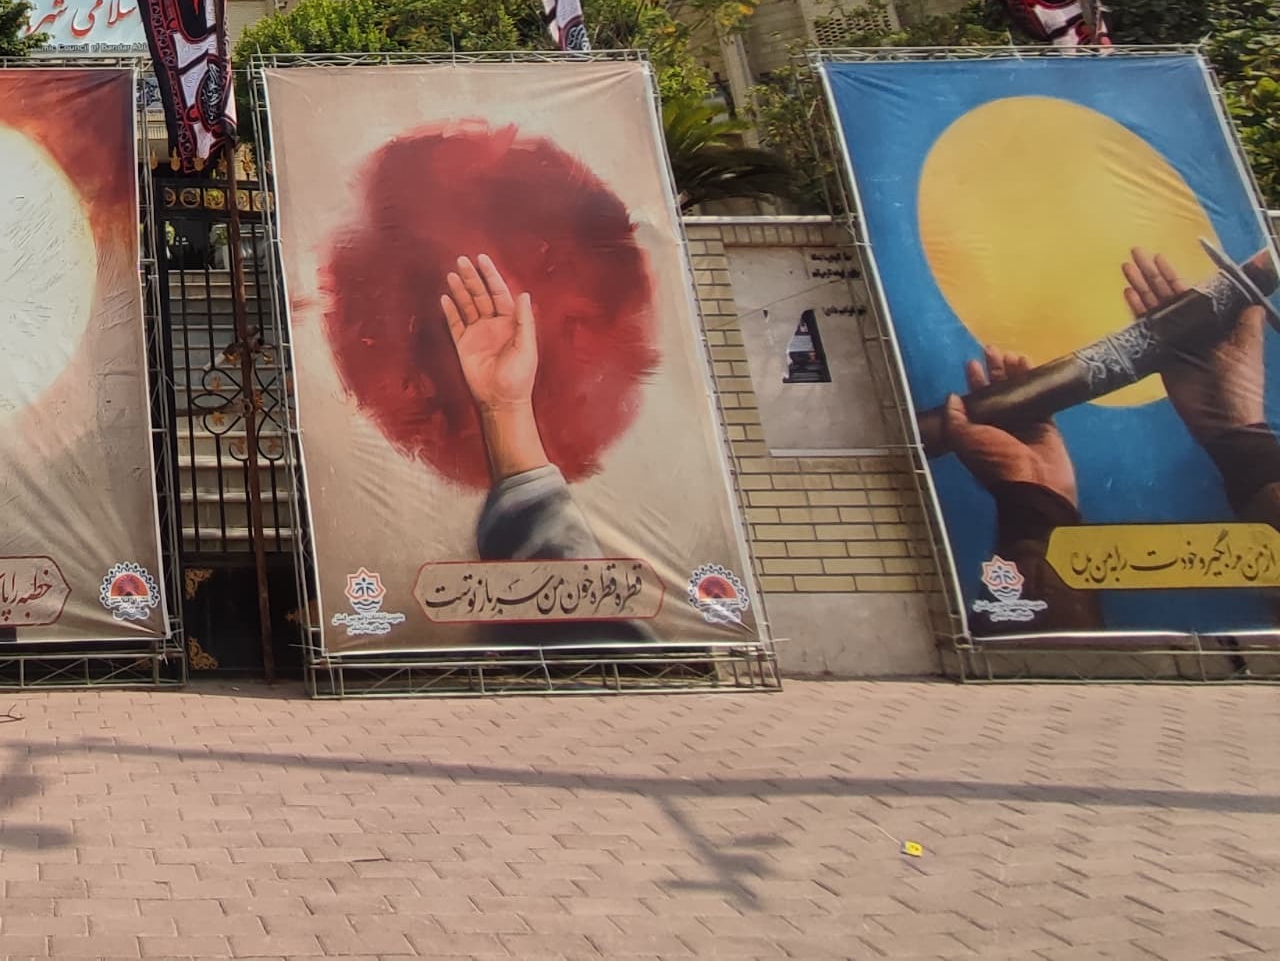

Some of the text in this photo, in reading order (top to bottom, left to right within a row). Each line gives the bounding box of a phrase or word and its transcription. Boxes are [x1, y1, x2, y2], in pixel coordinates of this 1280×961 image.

[559, 565, 594, 615] خون
[588, 563, 618, 614] قطره
[615, 564, 643, 613] قطره
[1240, 550, 1264, 582] من
[17, 569, 53, 619] خطبه
[536, 577, 565, 615] من
